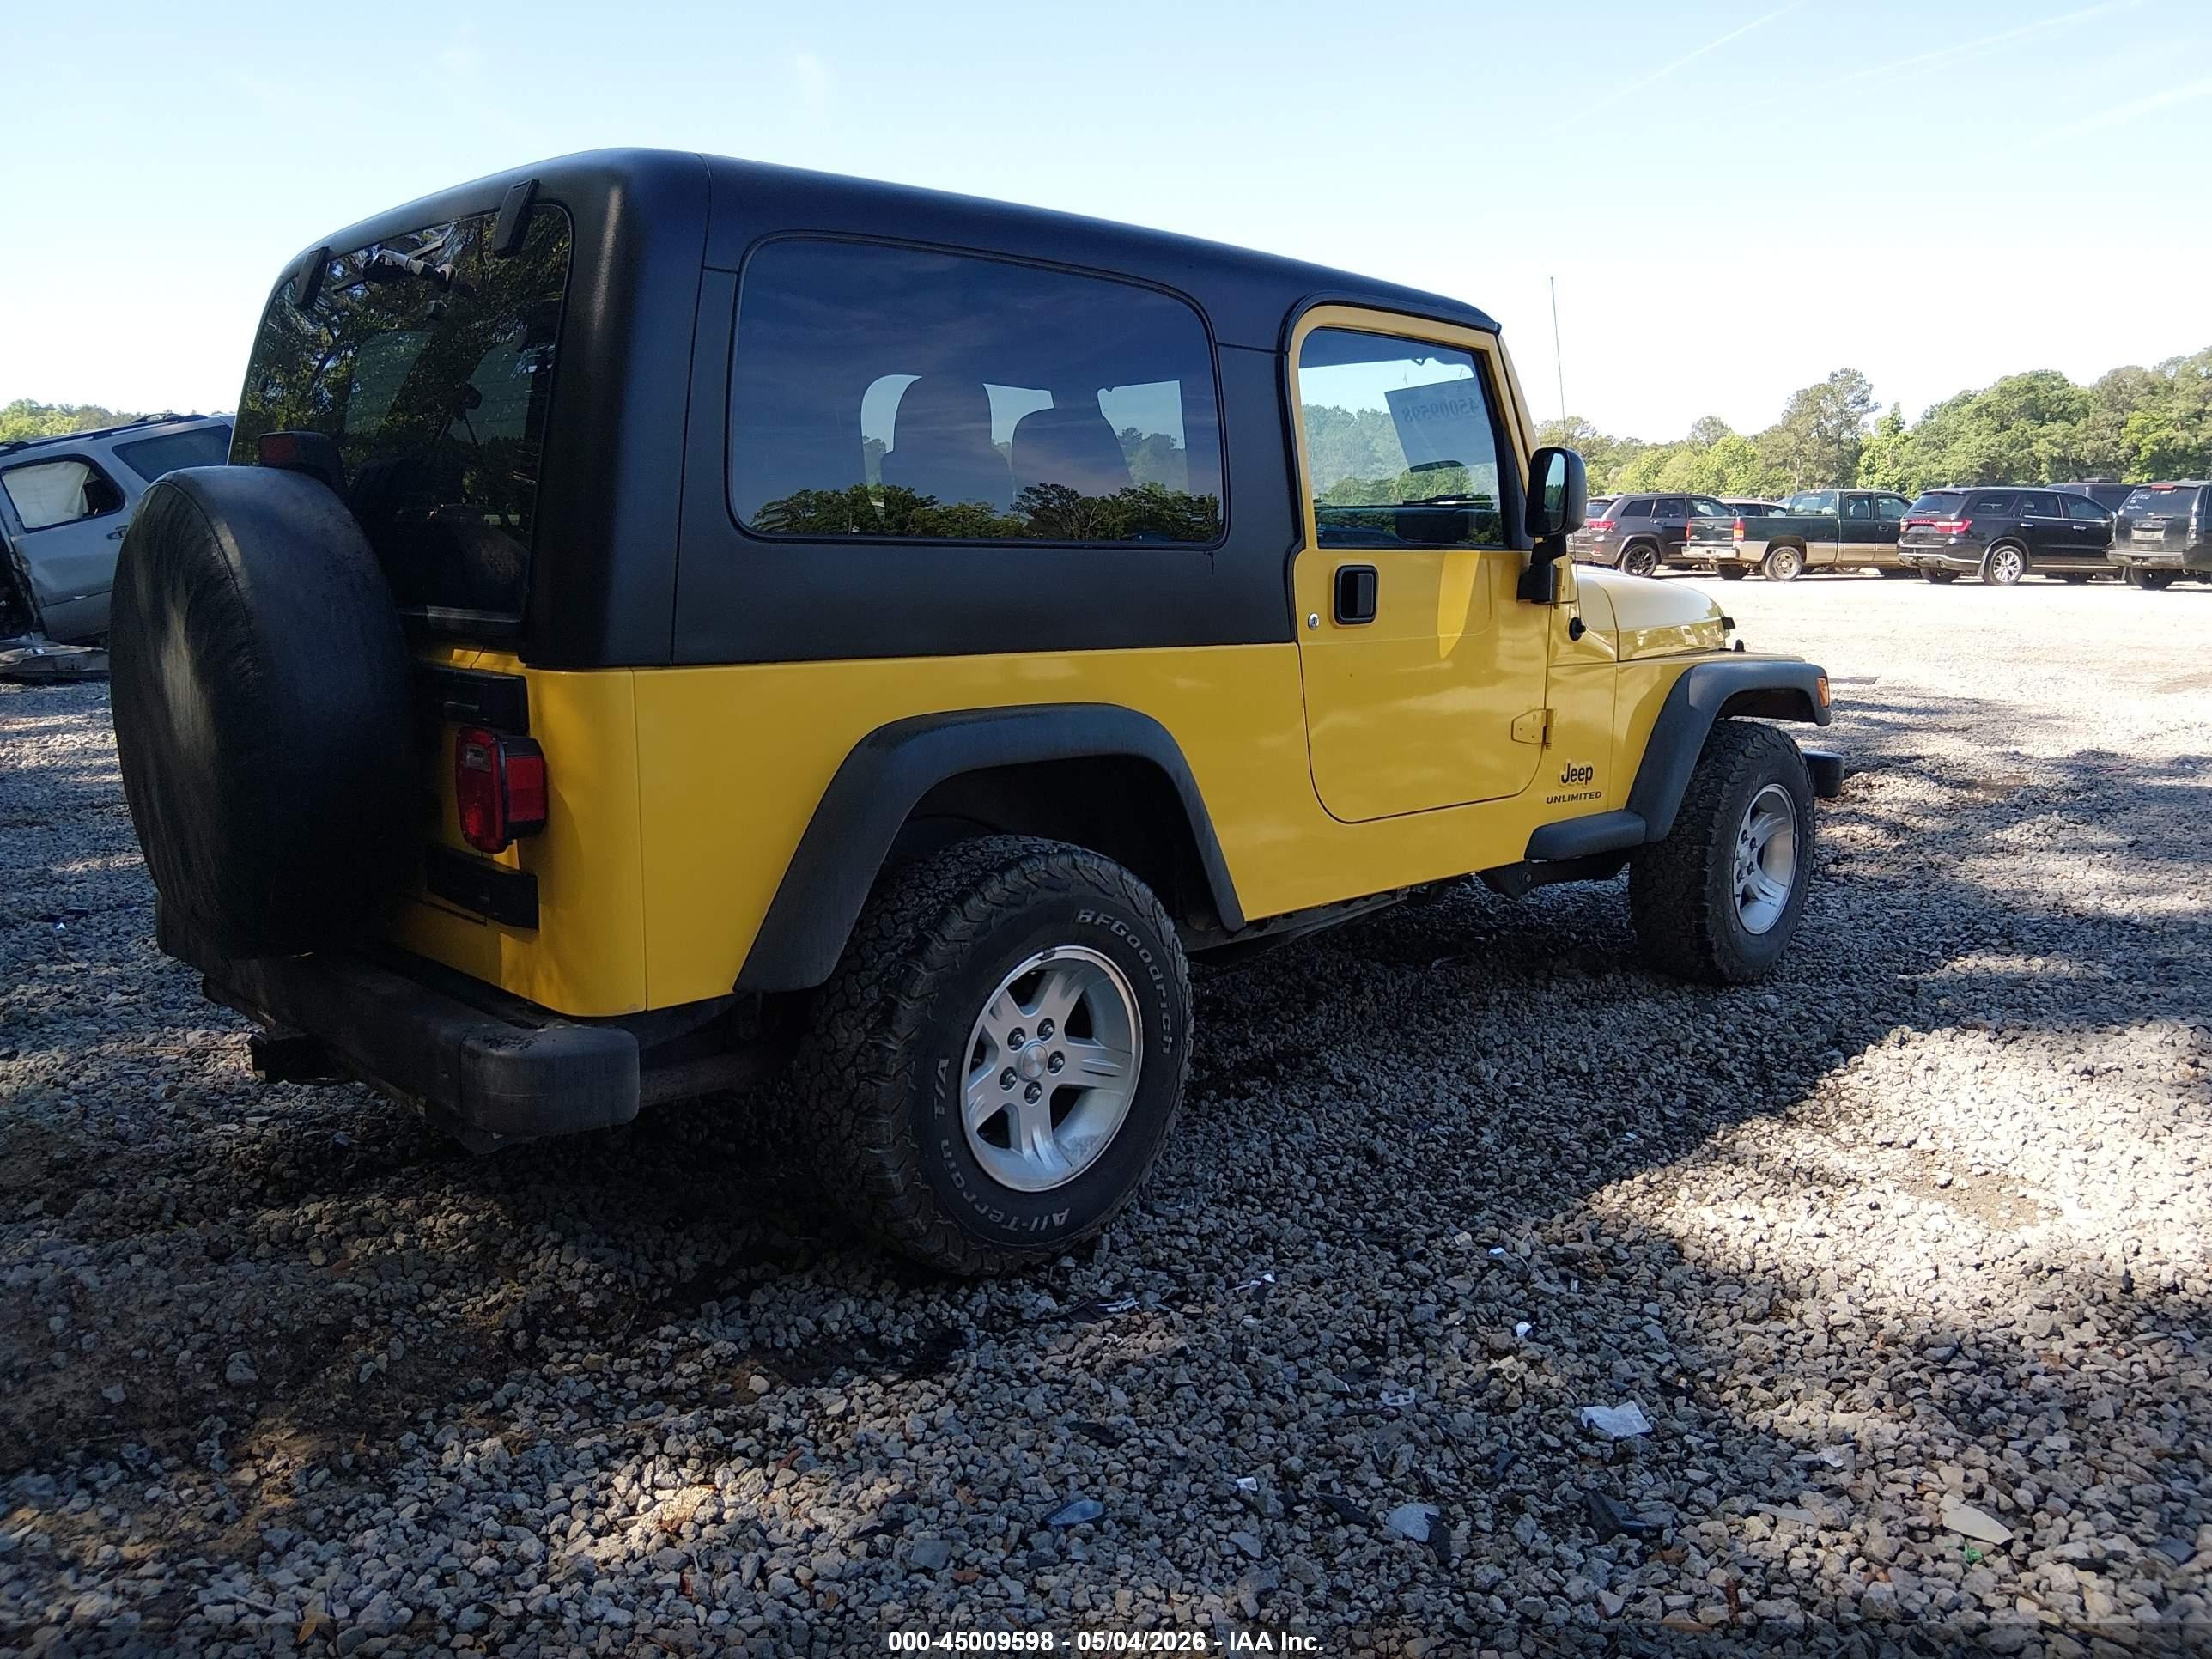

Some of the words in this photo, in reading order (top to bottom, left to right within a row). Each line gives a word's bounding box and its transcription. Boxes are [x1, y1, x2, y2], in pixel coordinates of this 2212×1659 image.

[1560, 762, 1594, 786] Jeep
[1546, 791, 1602, 804] UNLIMITED
[1077, 908, 1173, 1054] BFGoodrich
[933, 1059, 951, 1121] T/A
